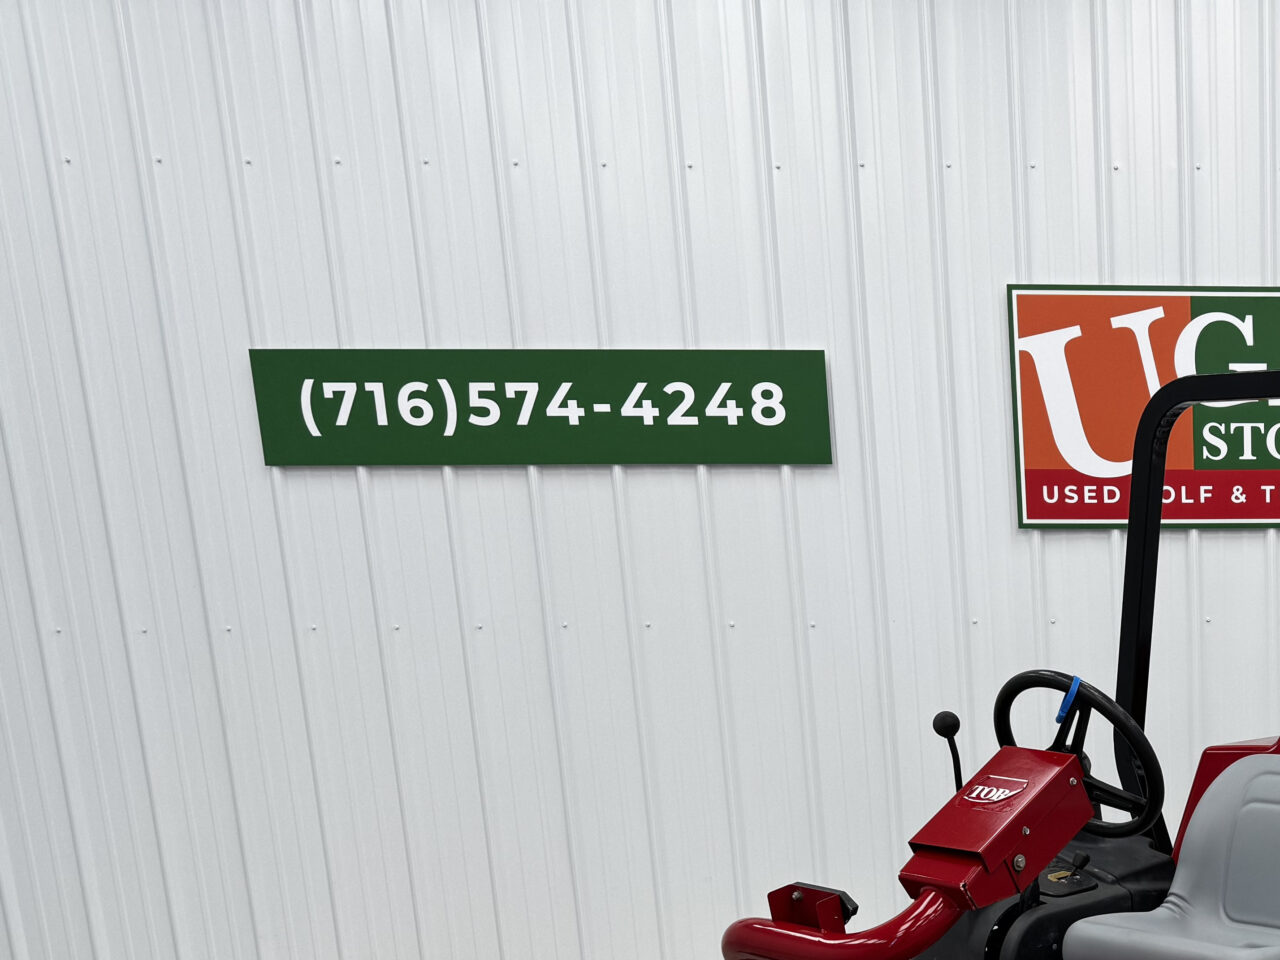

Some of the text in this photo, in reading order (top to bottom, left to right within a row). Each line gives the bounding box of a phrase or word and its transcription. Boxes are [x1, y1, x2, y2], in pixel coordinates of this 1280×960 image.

[300, 378, 787, 437] (716)574-4248
[1042, 485, 1121, 504] USED
[1161, 485, 1213, 504] OLF
[1230, 485, 1247, 504] &
